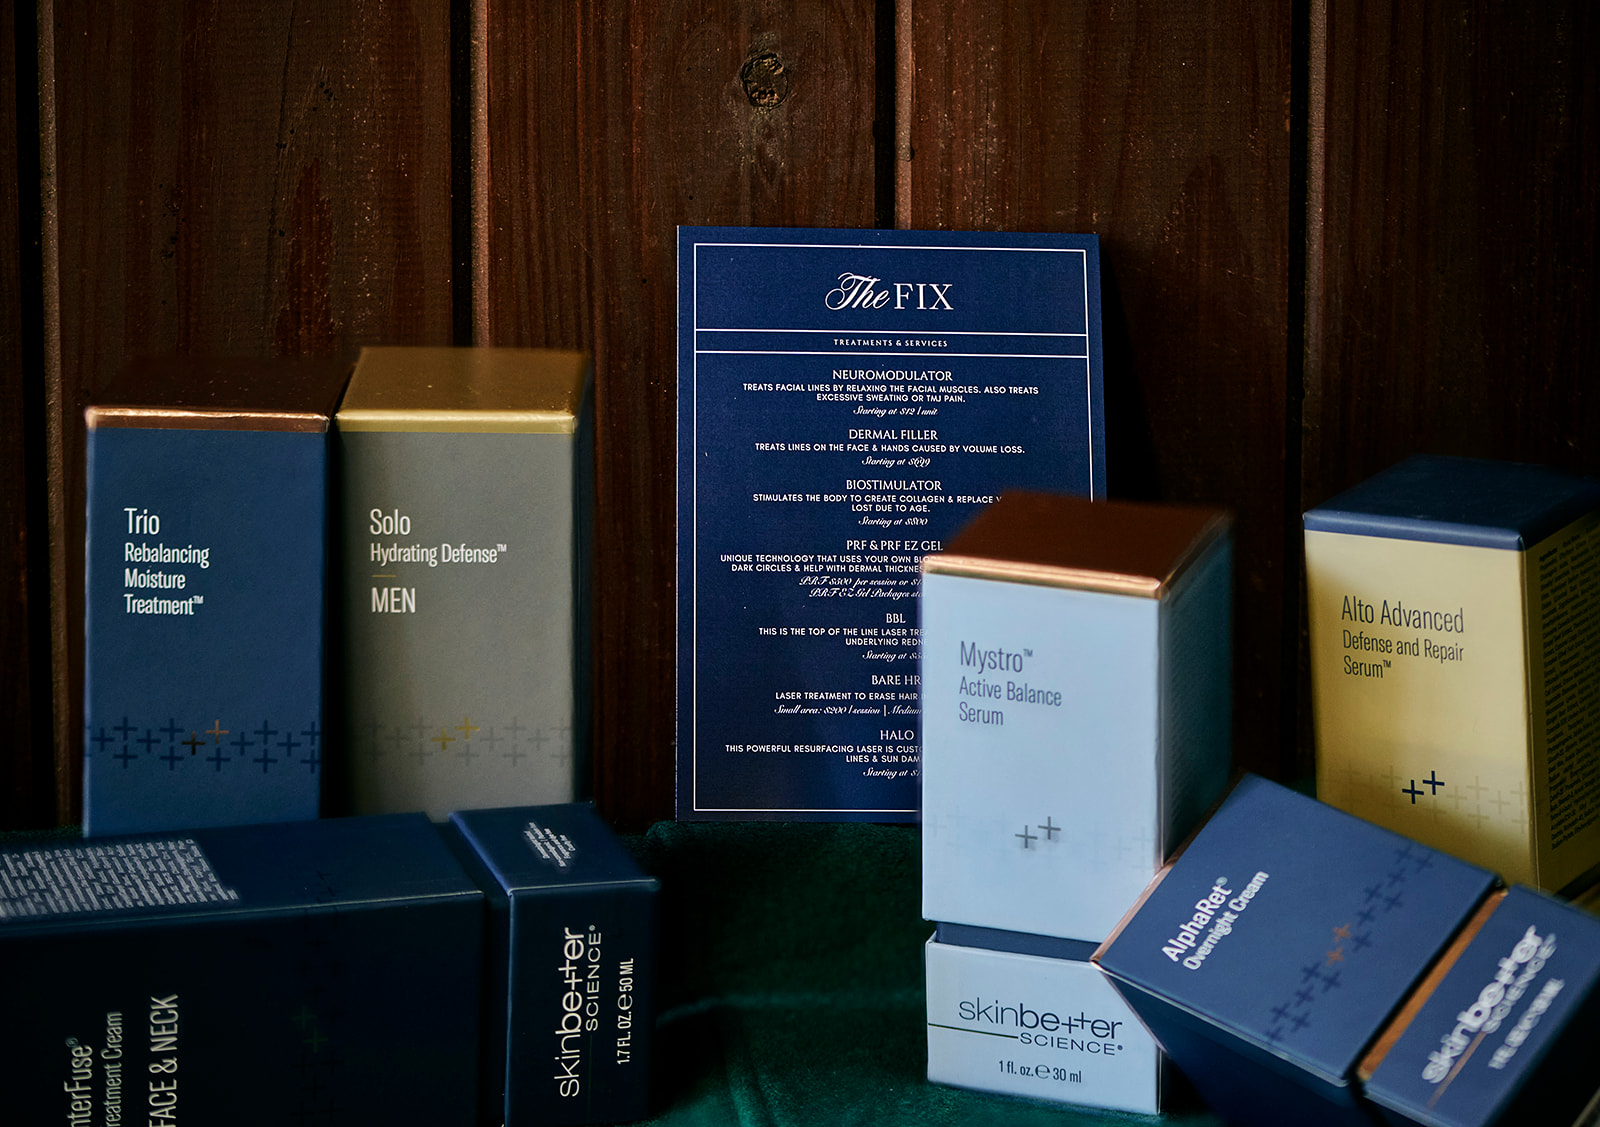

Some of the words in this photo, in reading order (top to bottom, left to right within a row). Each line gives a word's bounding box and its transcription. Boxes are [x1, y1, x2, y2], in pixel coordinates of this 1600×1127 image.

[825, 272, 891, 310] The
[893, 283, 954, 310] FIX
[833, 370, 952, 380] NEUROMODULATOR
[743, 383, 773, 391] TREATS
[776, 383, 805, 391] FACIAL
[833, 384, 843, 392] BY
[890, 385, 904, 393] THE
[908, 385, 936, 393] FACIAL
[939, 386, 981, 394] MUSCLES.
[984, 386, 1006, 394] ALSO
[817, 393, 863, 401] EXCESSIVE
[911, 394, 923, 402] OR
[849, 430, 897, 439] DERMAL
[901, 429, 938, 440] FILLER
[755, 443, 785, 451] TREATS
[788, 443, 811, 451] LINES
[829, 443, 843, 452] THE
[847, 443, 868, 452] FACE
[881, 444, 909, 453] HANDS
[912, 444, 946, 452] CAUSED
[963, 445, 997, 453] VOLUME
[847, 480, 942, 491] BIOSTIMULATOR
[753, 493, 803, 502] STIMULATES
[805, 494, 821, 502] THE
[823, 494, 848, 503] BODY
[850, 495, 862, 503] TO
[864, 495, 897, 503] CREATE
[899, 495, 945, 504] COLLAGEN
[956, 496, 994, 504] REPLACE
[852, 503, 872, 512] LOST
[896, 504, 906, 512] TO
[910, 504, 930, 512] AGE.
[124, 507, 160, 535] Trio
[369, 508, 411, 536] Solo
[847, 539, 866, 550] PRF
[870, 540, 878, 550] &
[881, 540, 900, 550] PRF
[905, 540, 918, 551] EZ
[921, 540, 943, 551] GEL
[124, 542, 210, 569] Rebalancing
[371, 543, 438, 567] Hydrating
[756, 554, 814, 563] TECHNOLOGY
[817, 555, 837, 563] THAT
[840, 555, 861, 563] USES
[891, 556, 910, 564] OWN
[756, 564, 791, 572] CIRCLES
[795, 564, 800, 572] &
[826, 564, 845, 572] WITH
[849, 564, 882, 572] DERMAL
[124, 568, 186, 590] Moisture
[371, 587, 416, 614] MEN
[886, 613, 905, 624] BBL
[1341, 594, 1374, 624] Alto
[1380, 599, 1465, 634] Advanced
[759, 627, 777, 636] THIS
[780, 627, 787, 635] IS
[791, 627, 805, 635] THE
[828, 628, 840, 636] OF
[843, 628, 857, 636] THE
[882, 628, 907, 637] LASER
[846, 638, 898, 646] UNDERLYING
[1343, 629, 1393, 654] Defense
[1396, 637, 1420, 657] and
[1424, 638, 1464, 664] Repair
[872, 675, 900, 685] BARE
[905, 675, 922, 685] HR
[776, 691, 801, 700] LASER
[804, 692, 851, 700] TREATMENT
[855, 692, 866, 700] TO
[959, 676, 1002, 700] Active
[1006, 681, 1062, 707] Balance
[959, 701, 1004, 726] Serum
[881, 730, 914, 741] HALO
[747, 744, 791, 753] POWERFUL
[886, 745, 893, 753] IS
[846, 754, 869, 763] LINES
[901, 755, 920, 763] DAM
[1182, 910, 1239, 970] Overnight
[1228, 870, 1270, 912] Cream
[619, 957, 634, 975] ML
[619, 976, 634, 993] 50
[149, 993, 180, 1053] NECK
[100, 1010, 124, 1061] Cream
[617, 1030, 632, 1047] FL.
[616, 1049, 631, 1065] 1.7
[148, 1056, 178, 1075] &
[998, 1060, 1004, 1073] 1
[1006, 1060, 1017, 1075] fl.
[1052, 1067, 1067, 1081] 30
[1069, 1070, 1082, 1084] ml
[148, 1078, 178, 1127] FACE
